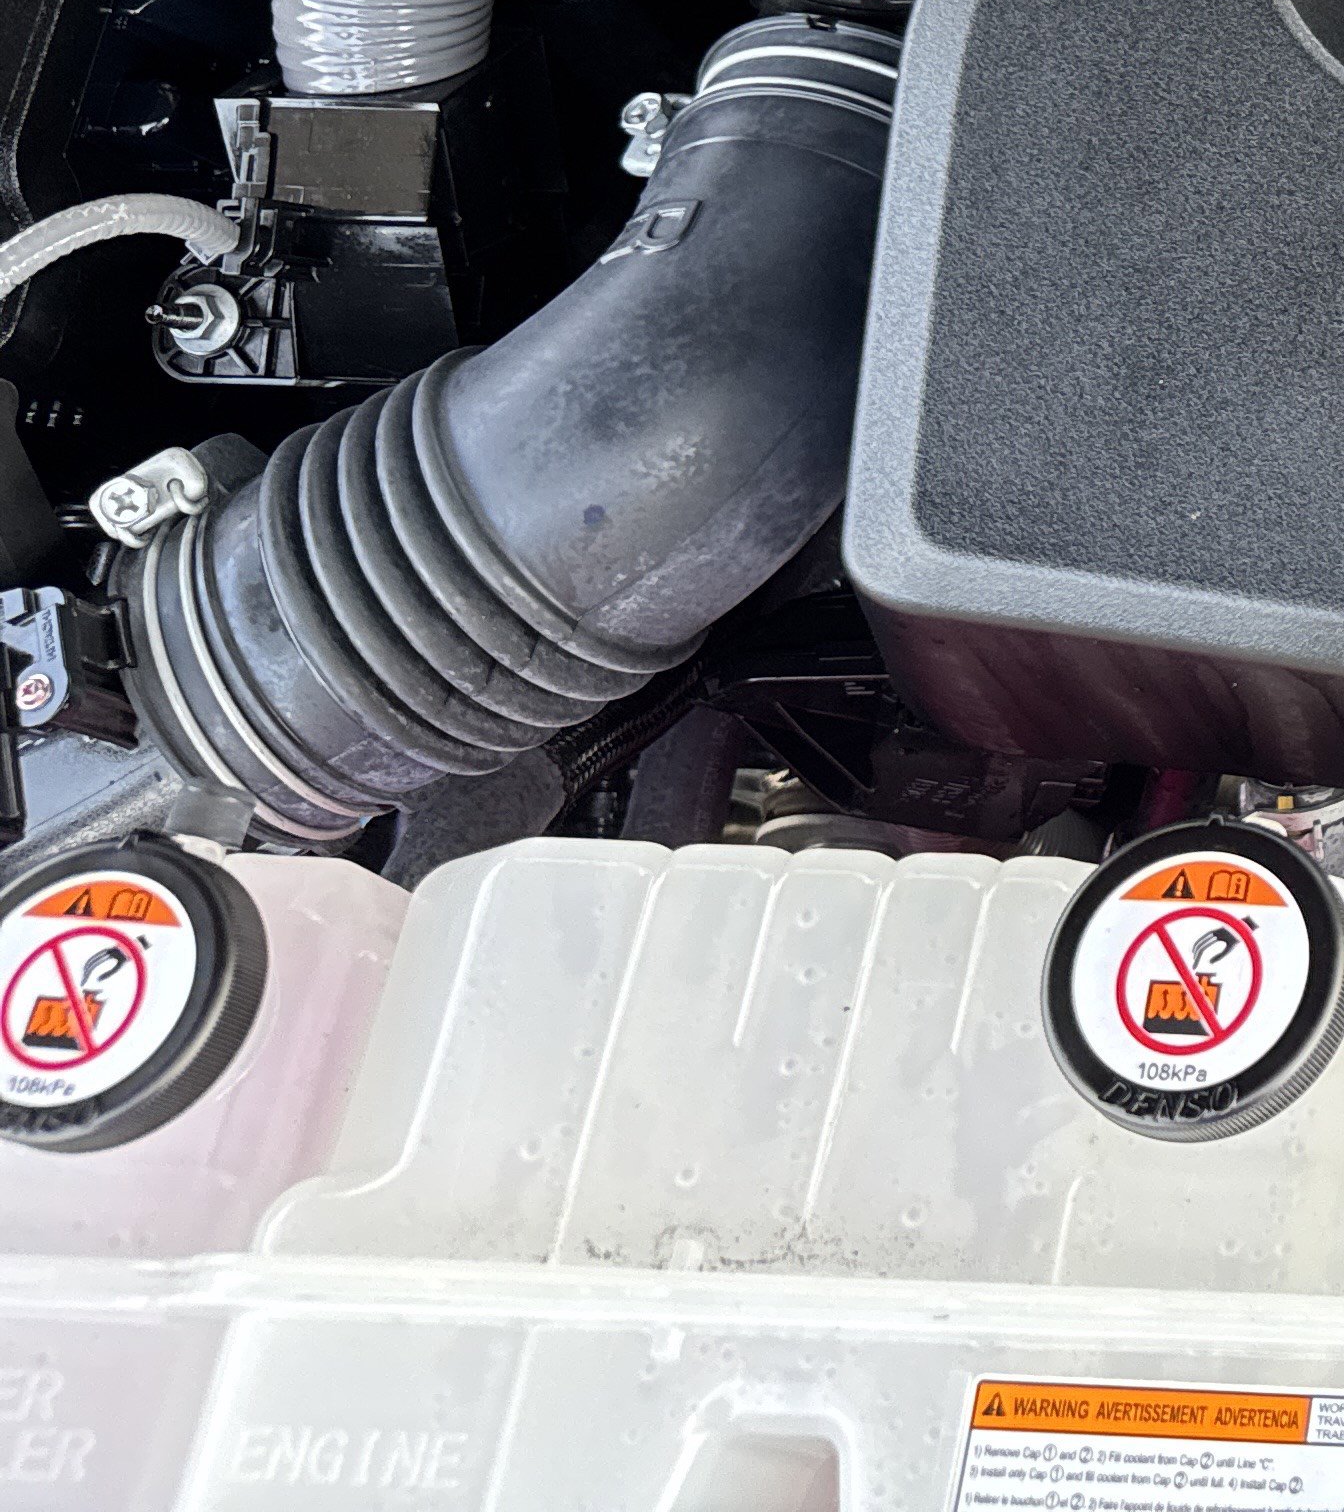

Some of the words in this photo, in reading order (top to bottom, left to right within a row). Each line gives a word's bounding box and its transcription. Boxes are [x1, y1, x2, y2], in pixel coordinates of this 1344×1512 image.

[1137, 1061, 1208, 1083] 108kPa
[1099, 1080, 1239, 1122] DENSO
[1013, 1395, 1089, 1420] WARNING
[1095, 1399, 1208, 1426] AVERTISSEMENT
[1214, 1405, 1299, 1431] ADVERTENCIA
[236, 1425, 469, 1490] ENGINE
